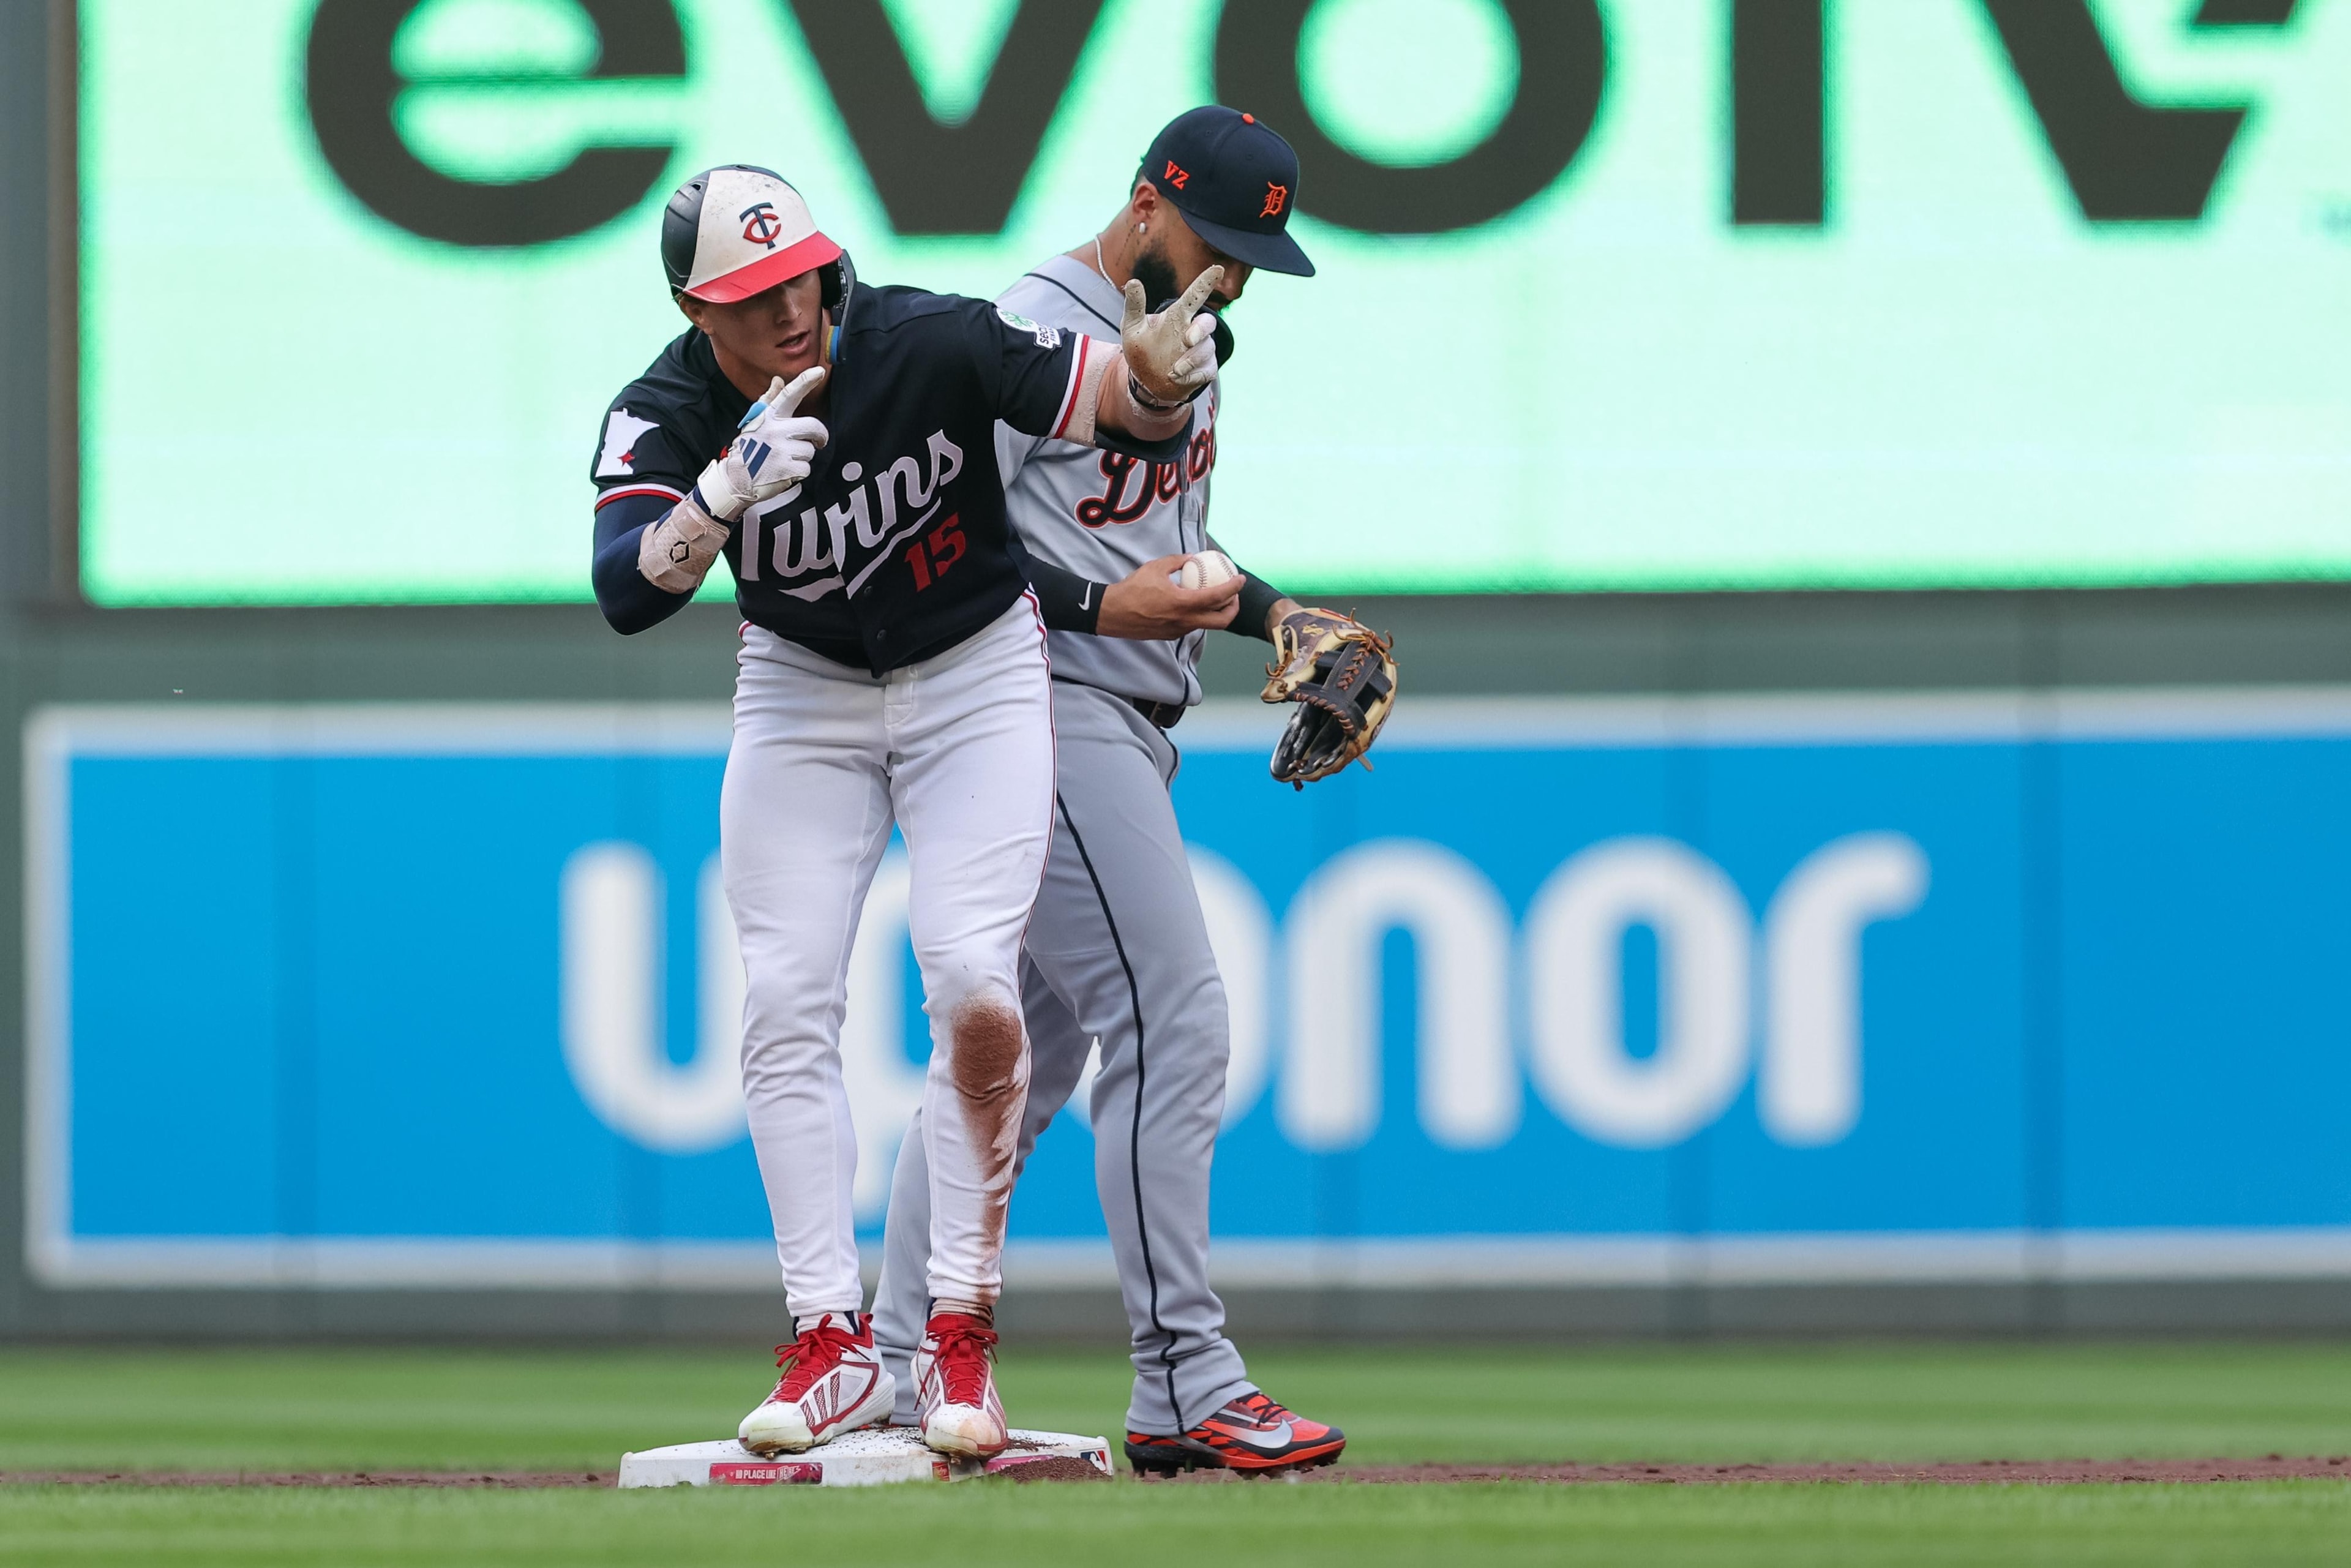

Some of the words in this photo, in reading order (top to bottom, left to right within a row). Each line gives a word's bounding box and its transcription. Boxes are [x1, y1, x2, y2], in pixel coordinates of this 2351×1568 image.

[1163, 160, 1190, 190] VZ
[739, 429, 964, 583] Twins
[904, 512, 967, 592] 15
[743, 1469, 765, 1479] PLACE
[766, 1469, 776, 1479] LIKE
